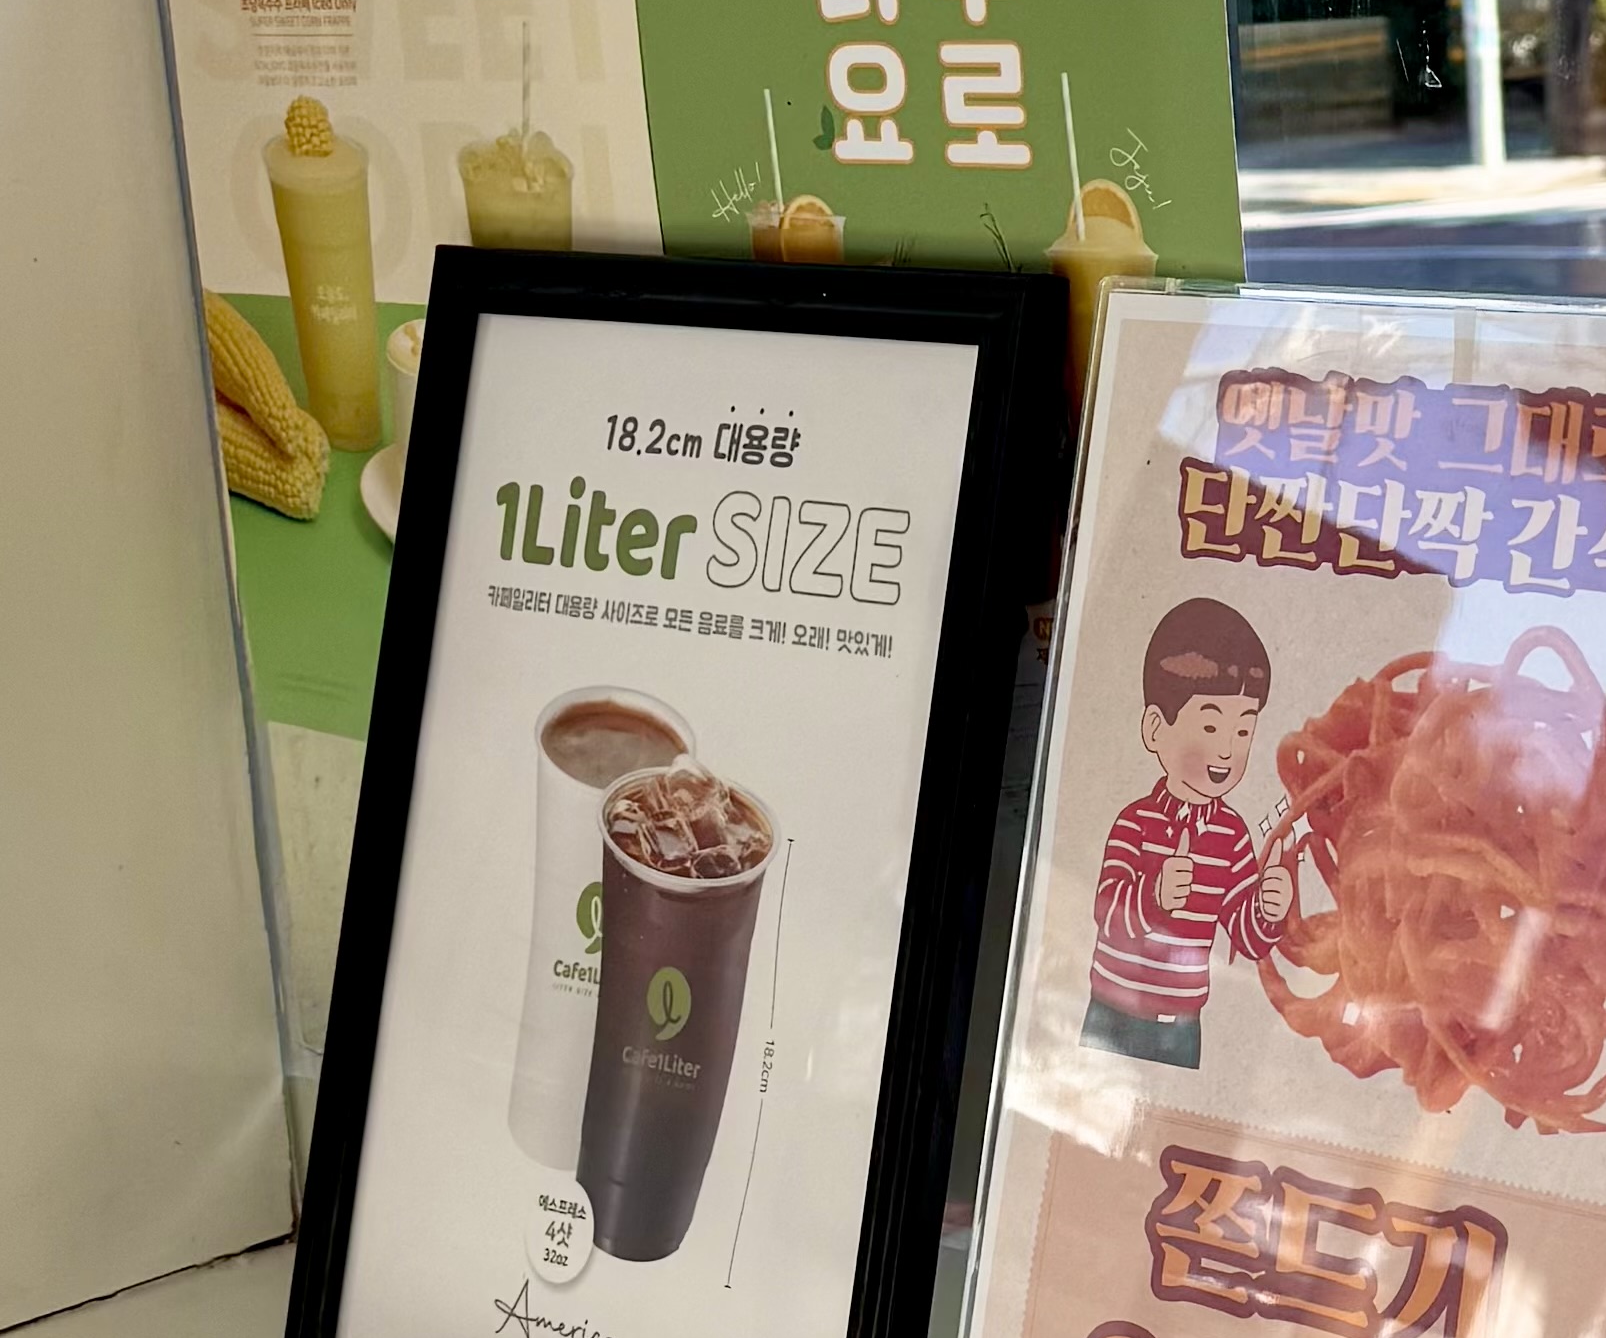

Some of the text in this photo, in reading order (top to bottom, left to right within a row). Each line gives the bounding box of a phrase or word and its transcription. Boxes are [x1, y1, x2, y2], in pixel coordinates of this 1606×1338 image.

[605, 414, 801, 468] 18.2cm 대용량
[1221, 379, 1422, 472] 옛날맛
[496, 476, 911, 606] 1Liter SIZE
[1183, 464, 1495, 581] 단짠단짝
[487, 584, 893, 660] 카페일리터 대용량 사이즈로 모든 음료를 크게! 오래! 맛있게!
[622, 1046, 701, 1079] Cafe1Liter
[759, 1040, 775, 1093] 18.2cm
[539, 1194, 587, 1220] 에스프레소
[543, 1247, 569, 1267] 32oz
[545, 1221, 573, 1249] 4샷
